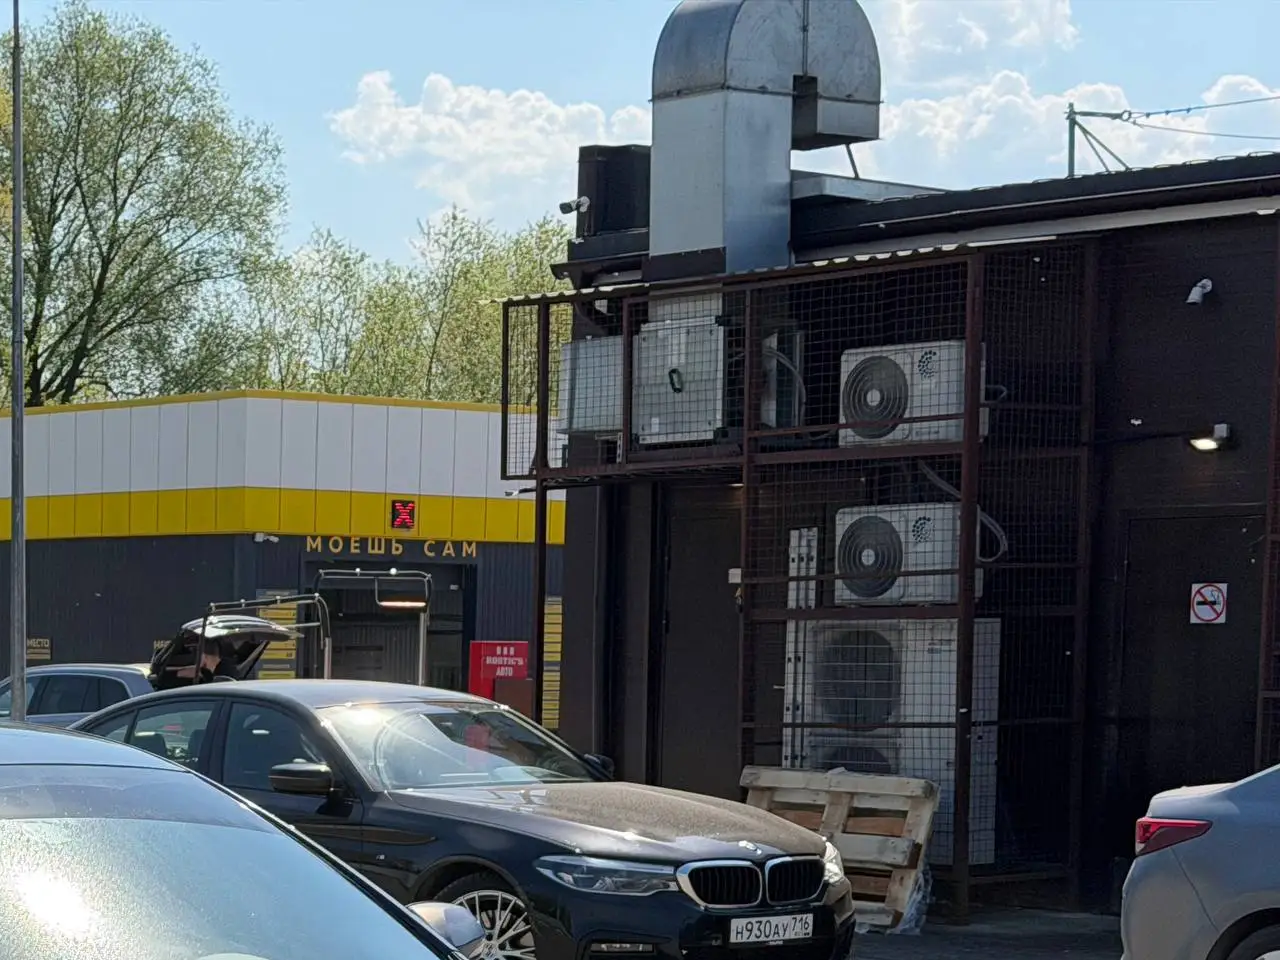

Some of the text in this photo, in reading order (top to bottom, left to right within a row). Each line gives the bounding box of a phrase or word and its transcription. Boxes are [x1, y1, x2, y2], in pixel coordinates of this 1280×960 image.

[306, 536, 477, 558] МОЕШЬ САМ
[735, 916, 810, 941] Н930АУ 716
